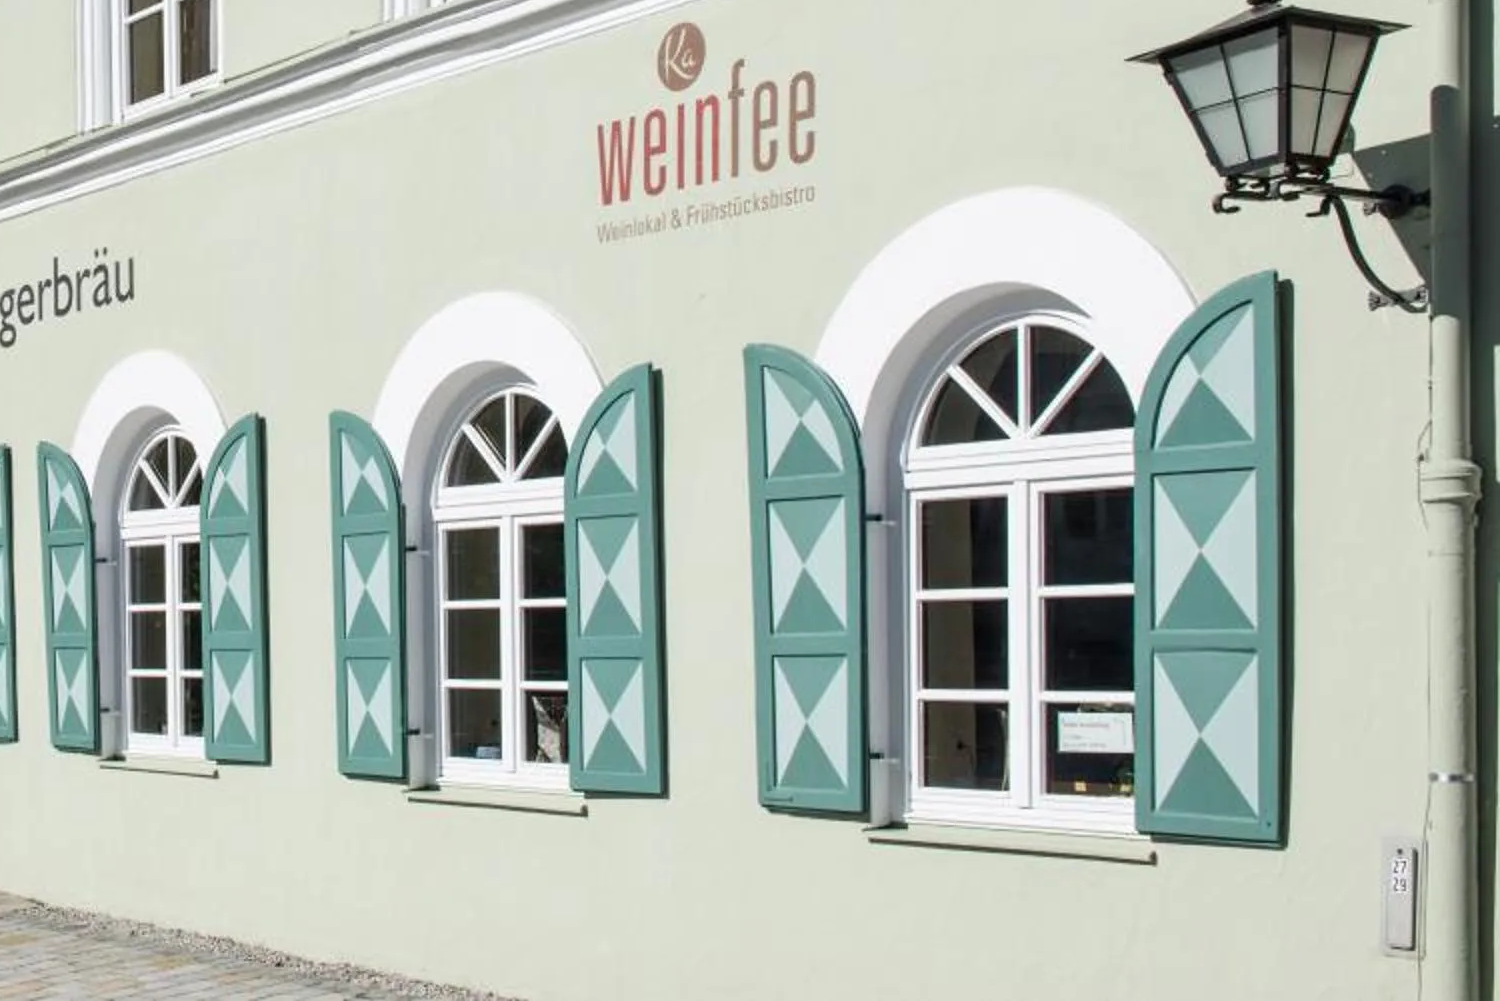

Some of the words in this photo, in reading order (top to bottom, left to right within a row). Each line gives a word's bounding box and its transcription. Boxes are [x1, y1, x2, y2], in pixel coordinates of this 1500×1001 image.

[597, 58, 816, 206] weinfee
[597, 212, 667, 244] Weinlokal
[670, 208, 682, 229] &
[686, 185, 816, 227] Frühstücksbistro
[1393, 860, 1407, 874] 27
